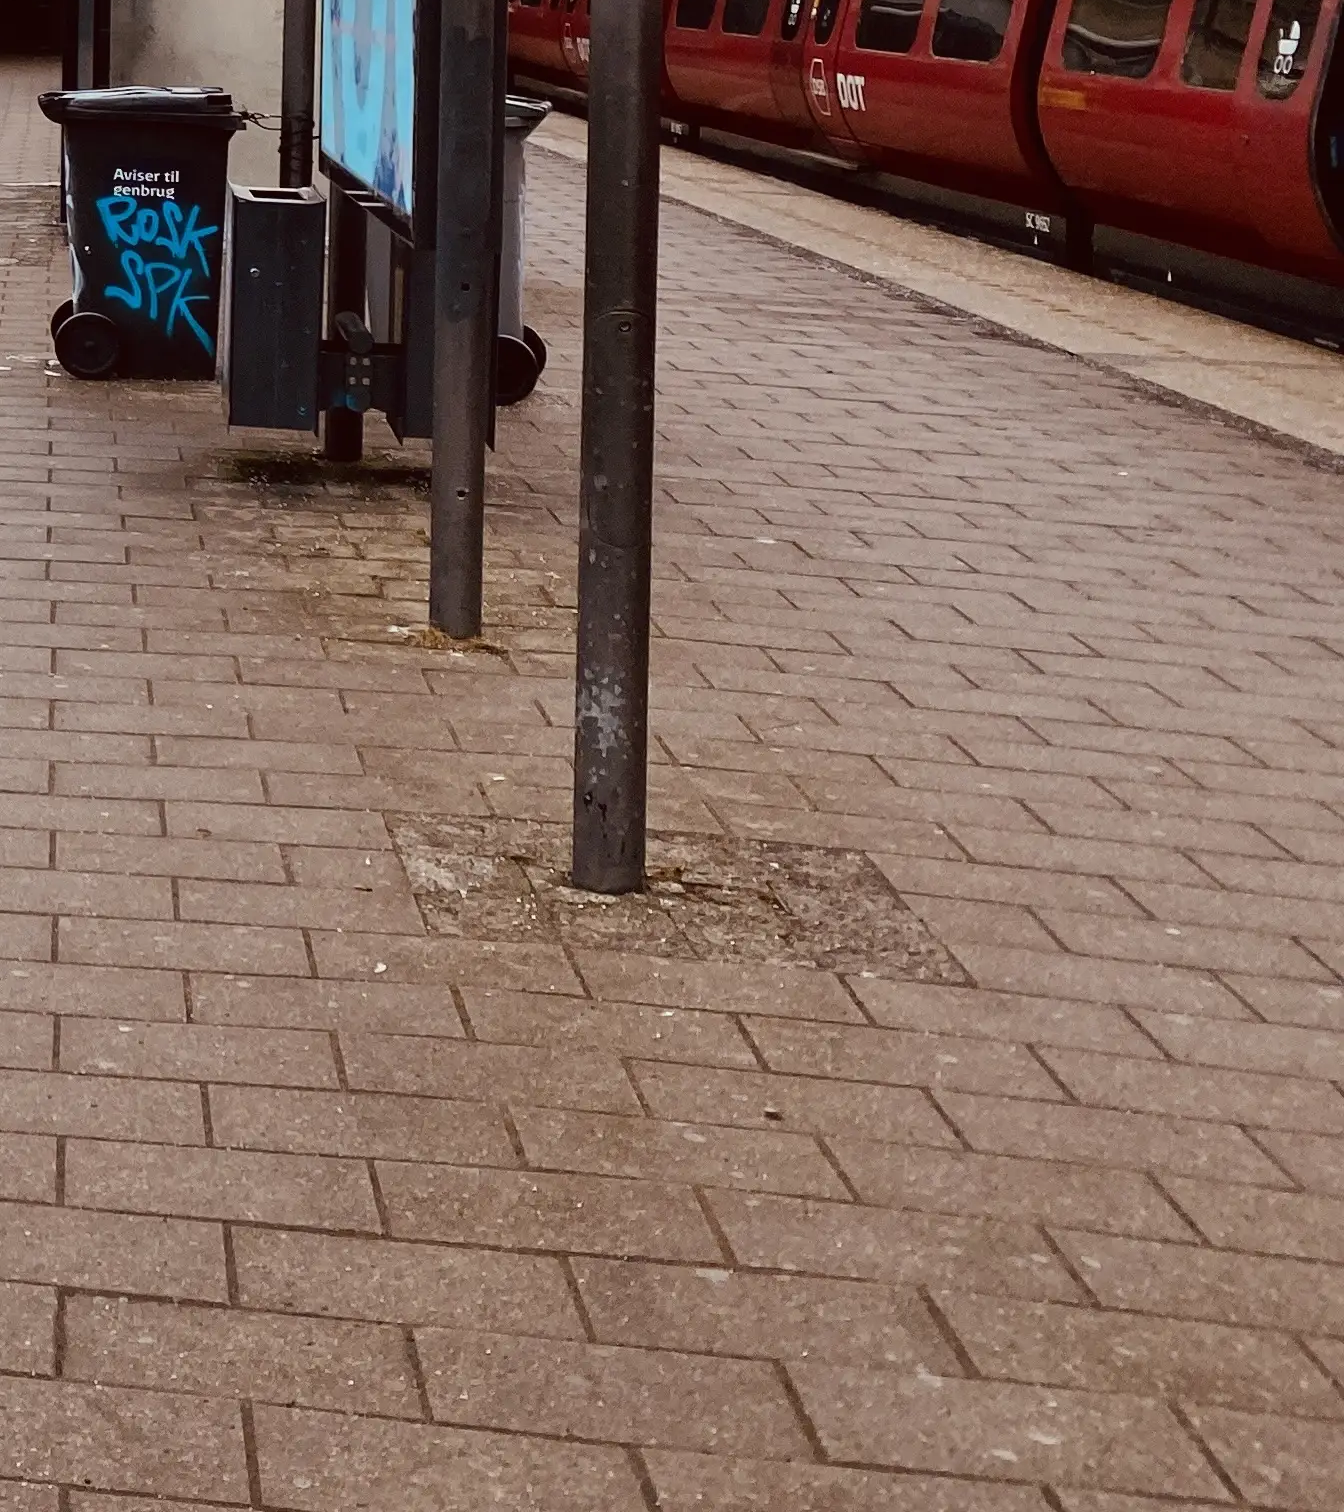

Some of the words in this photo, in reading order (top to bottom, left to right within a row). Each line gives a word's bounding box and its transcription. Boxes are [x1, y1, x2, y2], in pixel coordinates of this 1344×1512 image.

[113, 168, 161, 183] Aviser
[164, 170, 180, 183] til
[113, 184, 175, 200] genbrug
